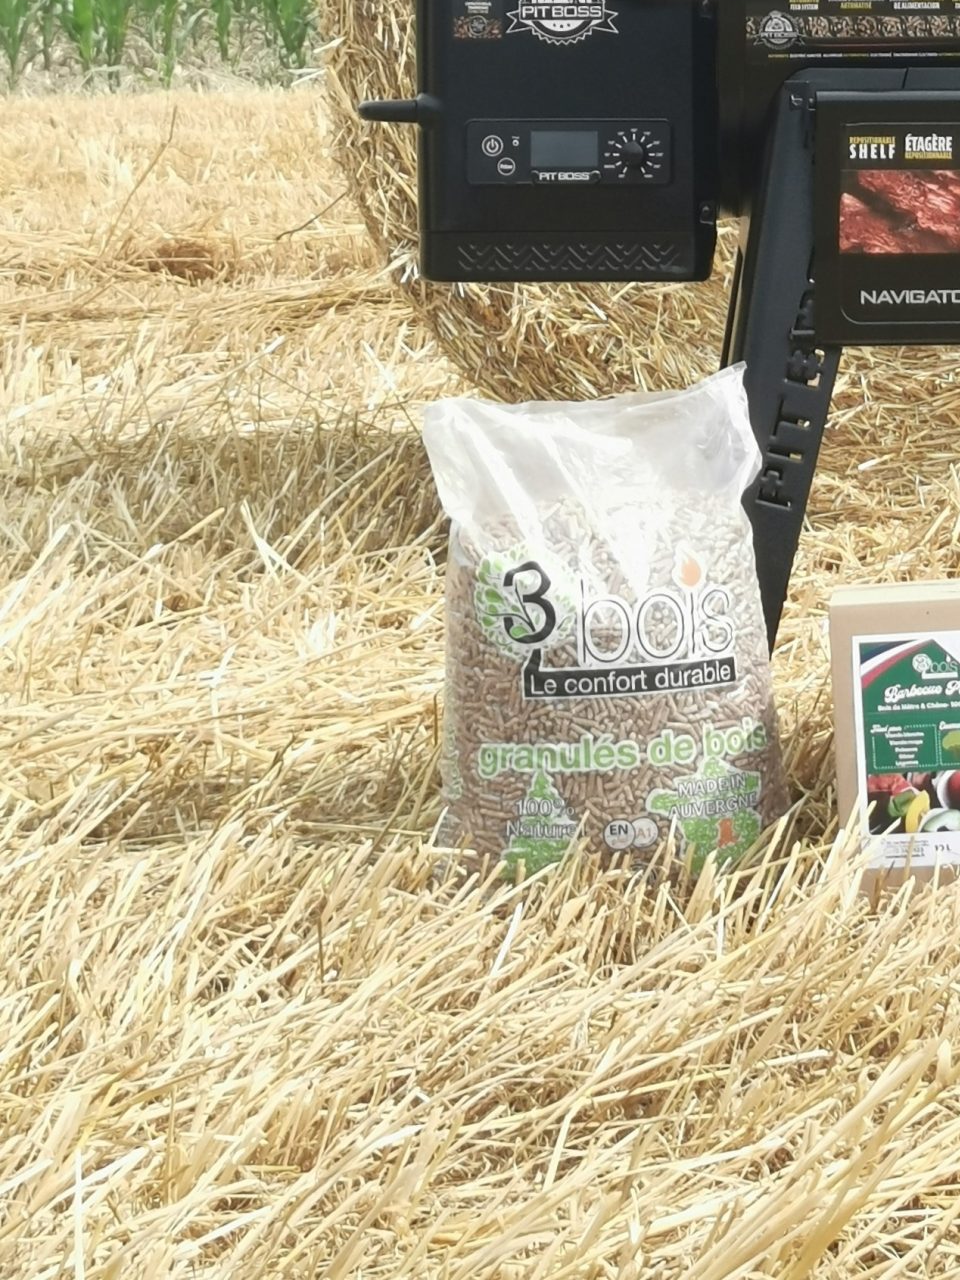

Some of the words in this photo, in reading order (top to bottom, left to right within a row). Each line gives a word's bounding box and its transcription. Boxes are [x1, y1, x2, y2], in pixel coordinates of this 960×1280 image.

[522, 5, 550, 18] PIT
[552, 5, 601, 18] BOSS
[849, 144, 896, 159] SHELF
[905, 133, 952, 152] ÉTAGÈRE
[538, 172, 557, 181] PIT
[558, 172, 589, 181] BOSS
[503, 560, 556, 644] 3
[580, 566, 734, 663] bois
[530, 673, 556, 695] Le
[564, 670, 647, 694] confort
[655, 661, 732, 687] durable
[884, 684, 943, 703] Barbecue
[479, 734, 640, 779] granulés
[650, 728, 696, 765] de
[702, 717, 767, 758] bois
[677, 776, 730, 797] MADE
[730, 771, 746, 789] IN
[515, 798, 575, 816] 100%
[669, 791, 757, 818] AUVERGNE
[609, 823, 628, 836] EN
